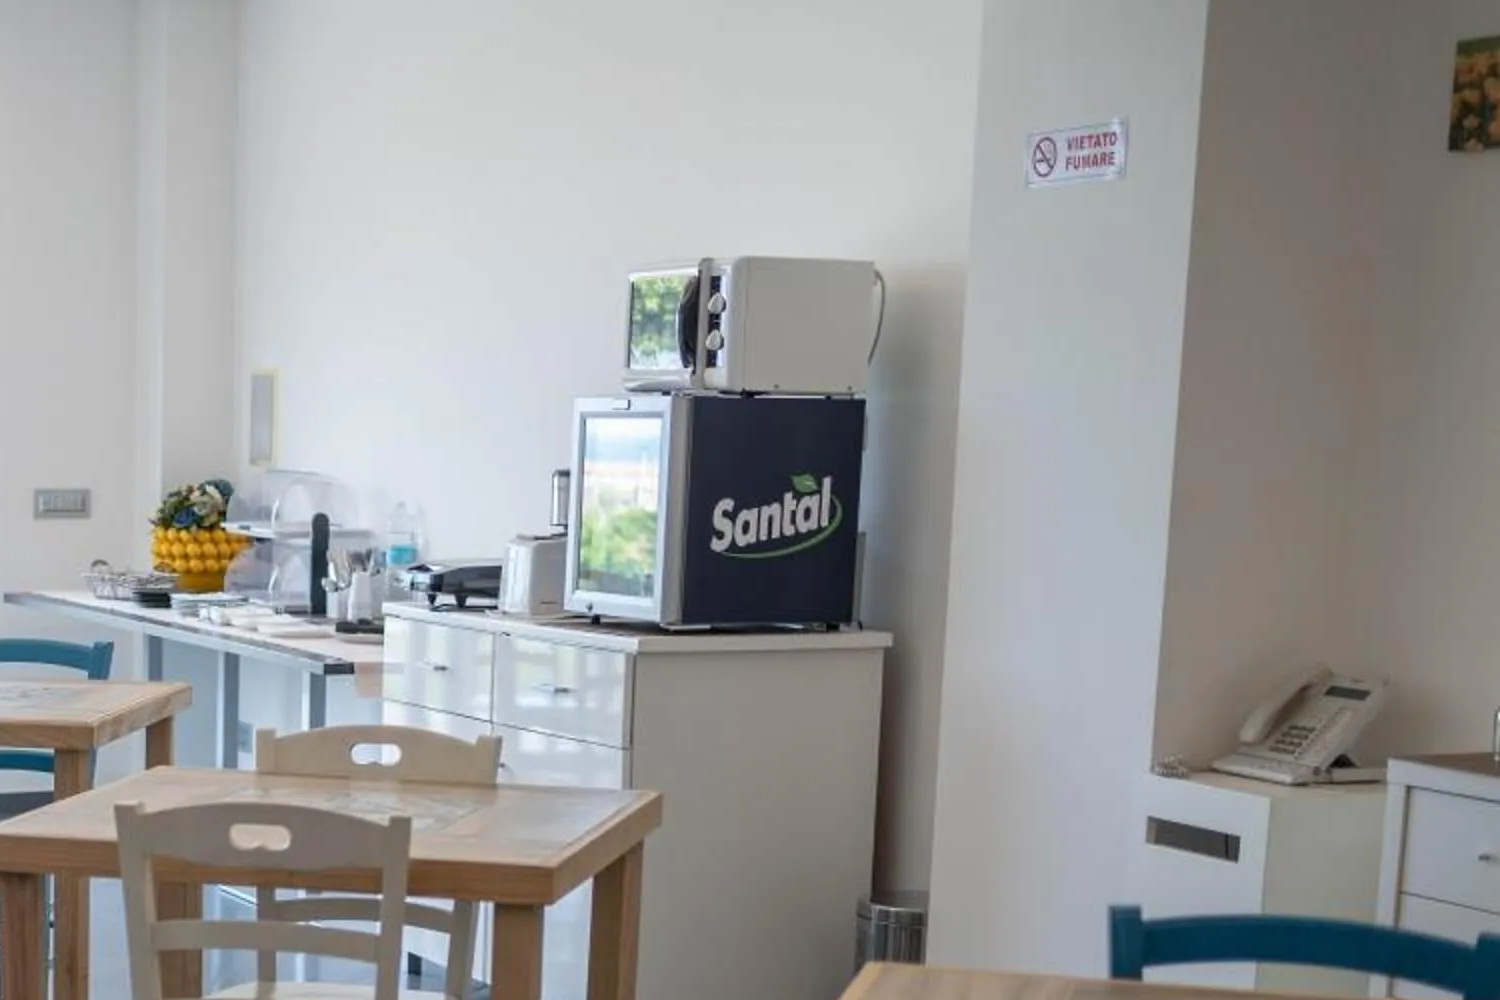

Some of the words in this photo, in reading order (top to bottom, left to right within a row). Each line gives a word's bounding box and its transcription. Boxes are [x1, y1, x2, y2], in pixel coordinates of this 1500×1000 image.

[1066, 131, 1118, 151] VIETATO
[1065, 151, 1116, 171] FUMARE
[710, 475, 832, 552] Santal
